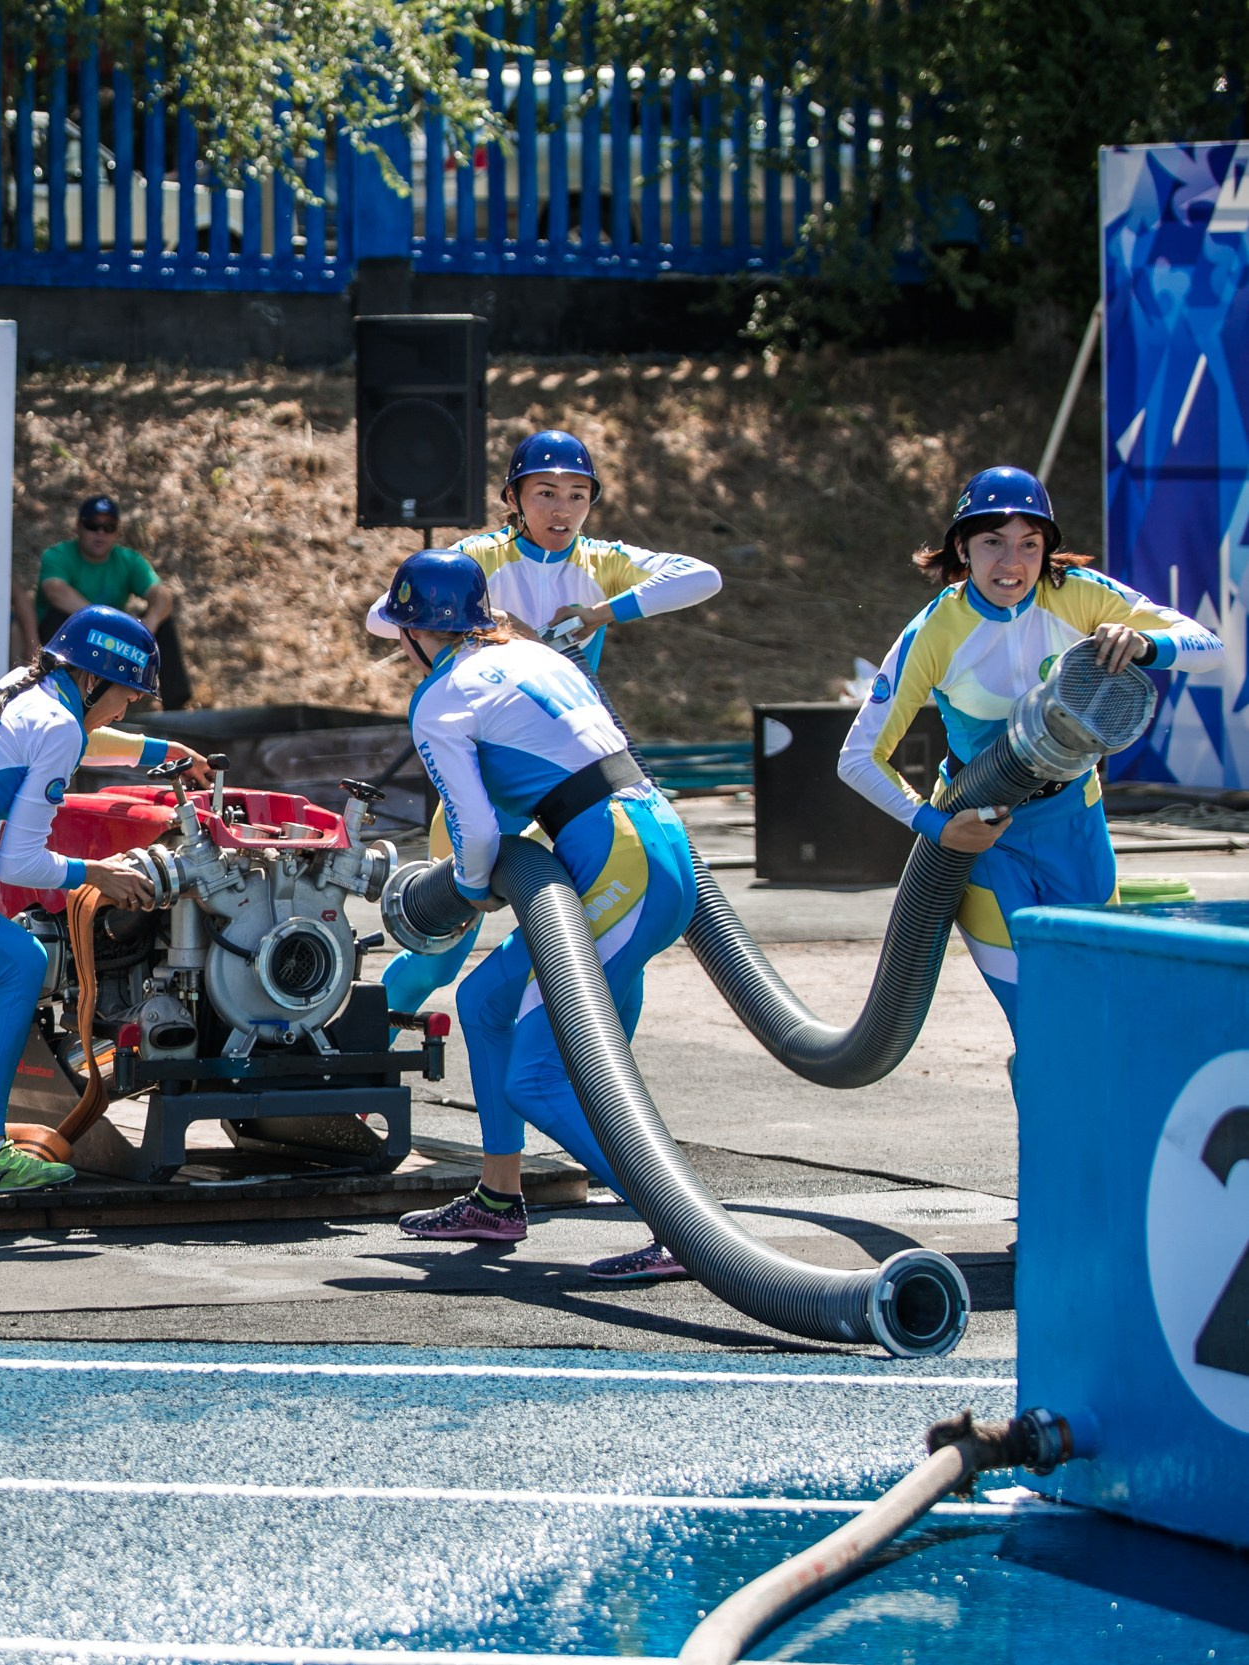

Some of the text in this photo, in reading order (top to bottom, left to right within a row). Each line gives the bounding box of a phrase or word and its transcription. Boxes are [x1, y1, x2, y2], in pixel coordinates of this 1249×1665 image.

[90, 632, 96, 643] I
[130, 648, 146, 664] KZ
[583, 880, 631, 922] port
